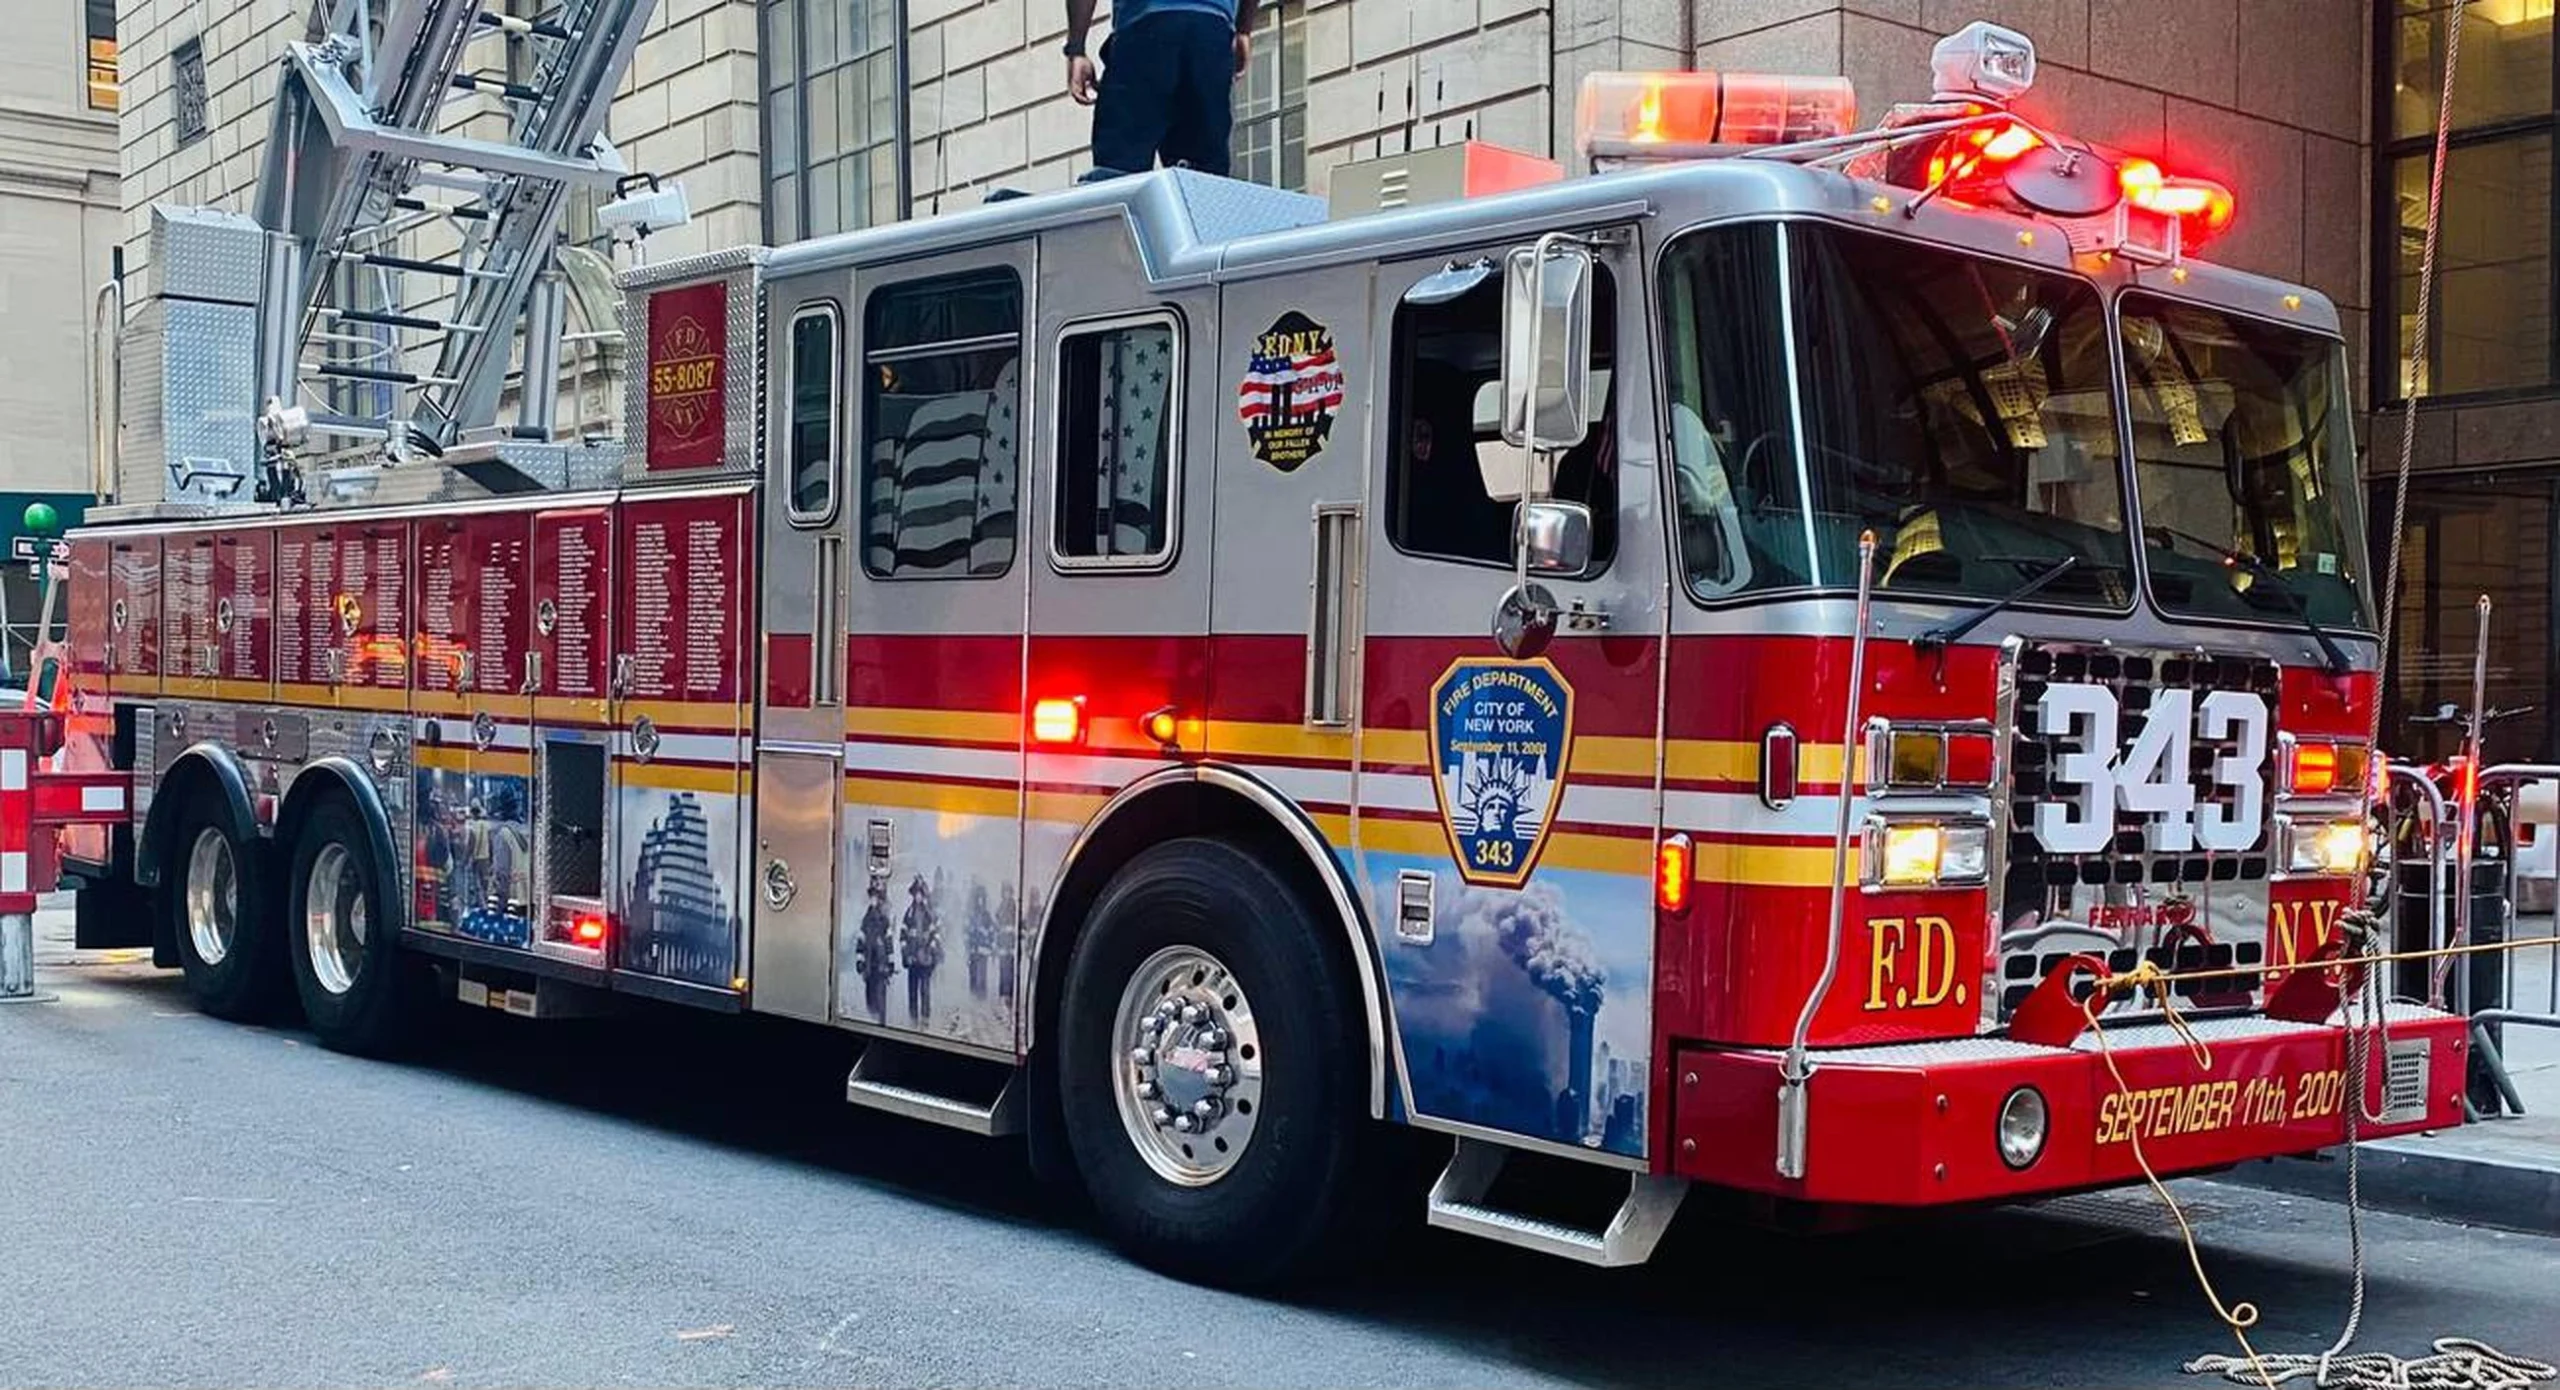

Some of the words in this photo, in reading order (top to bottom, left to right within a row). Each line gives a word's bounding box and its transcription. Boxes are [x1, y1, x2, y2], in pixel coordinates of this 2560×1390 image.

[653, 361, 715, 393] 55-8087
[1268, 440, 1284, 450] OUR
[1274, 428, 1304, 439] MEMORY
[1442, 684, 1472, 717] FIRE
[1472, 670, 1559, 719] DEPARTMENT
[1474, 701, 1505, 717] CITY
[1506, 702, 1526, 717] OF
[1464, 718, 1494, 733] NEW
[1496, 719, 1535, 734] YORK
[1450, 739, 1504, 755] September
[1506, 741, 1520, 757] 11,
[1521, 741, 1548, 756] 2001
[2033, 682, 2269, 854] 343
[1475, 838, 1514, 867] 343
[2088, 903, 2184, 930] FERRAR
[1864, 916, 1967, 1010] F.D.
[2095, 1080, 2238, 1145] SEPTEMBER
[2242, 1075, 2288, 1129] 11th,
[2291, 1070, 2348, 1120] 2001
